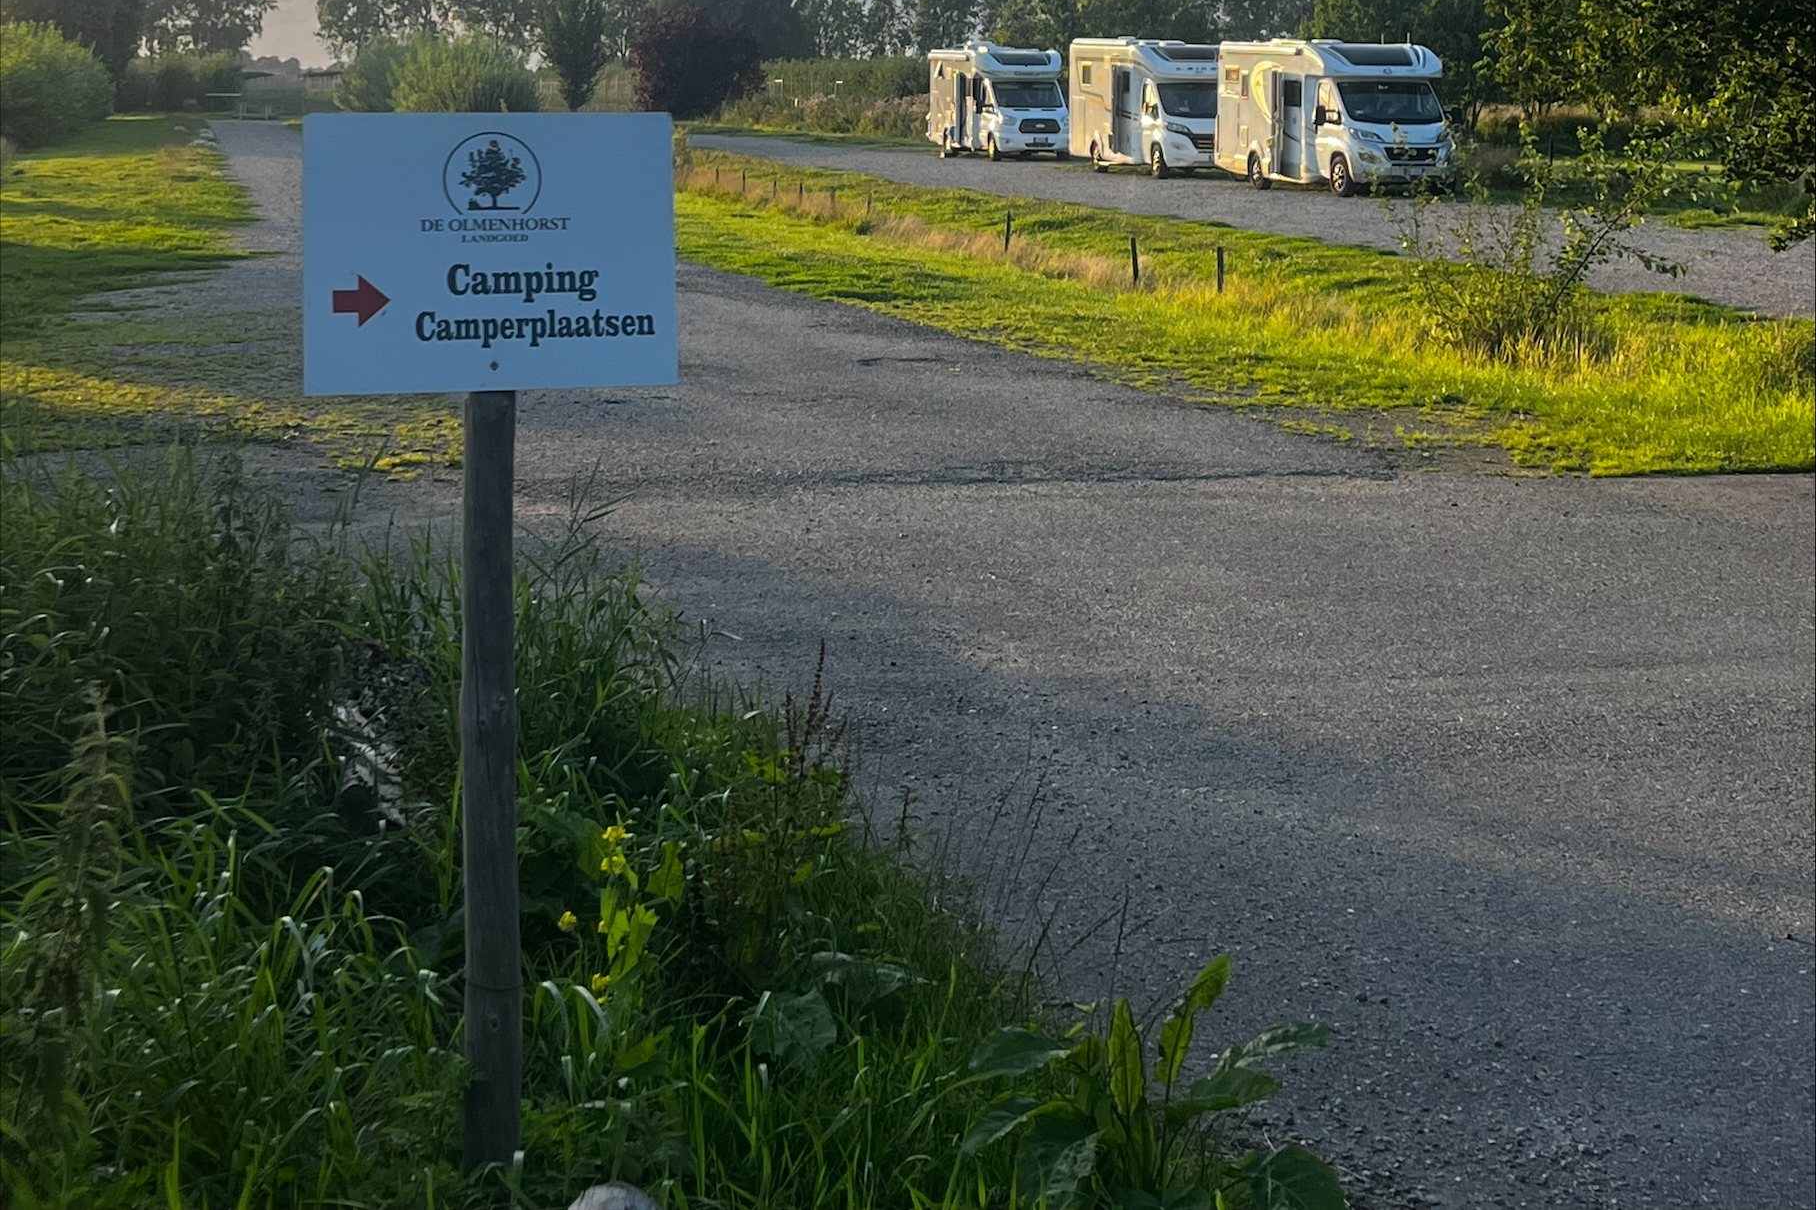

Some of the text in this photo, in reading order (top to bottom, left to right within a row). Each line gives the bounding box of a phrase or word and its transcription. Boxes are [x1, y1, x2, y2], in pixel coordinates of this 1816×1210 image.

[420, 217, 571, 232] DE OLMENHORST
[461, 234, 529, 243] LANDGOED
[447, 263, 599, 302] Camping
[415, 309, 656, 348] Camperplaatsen
